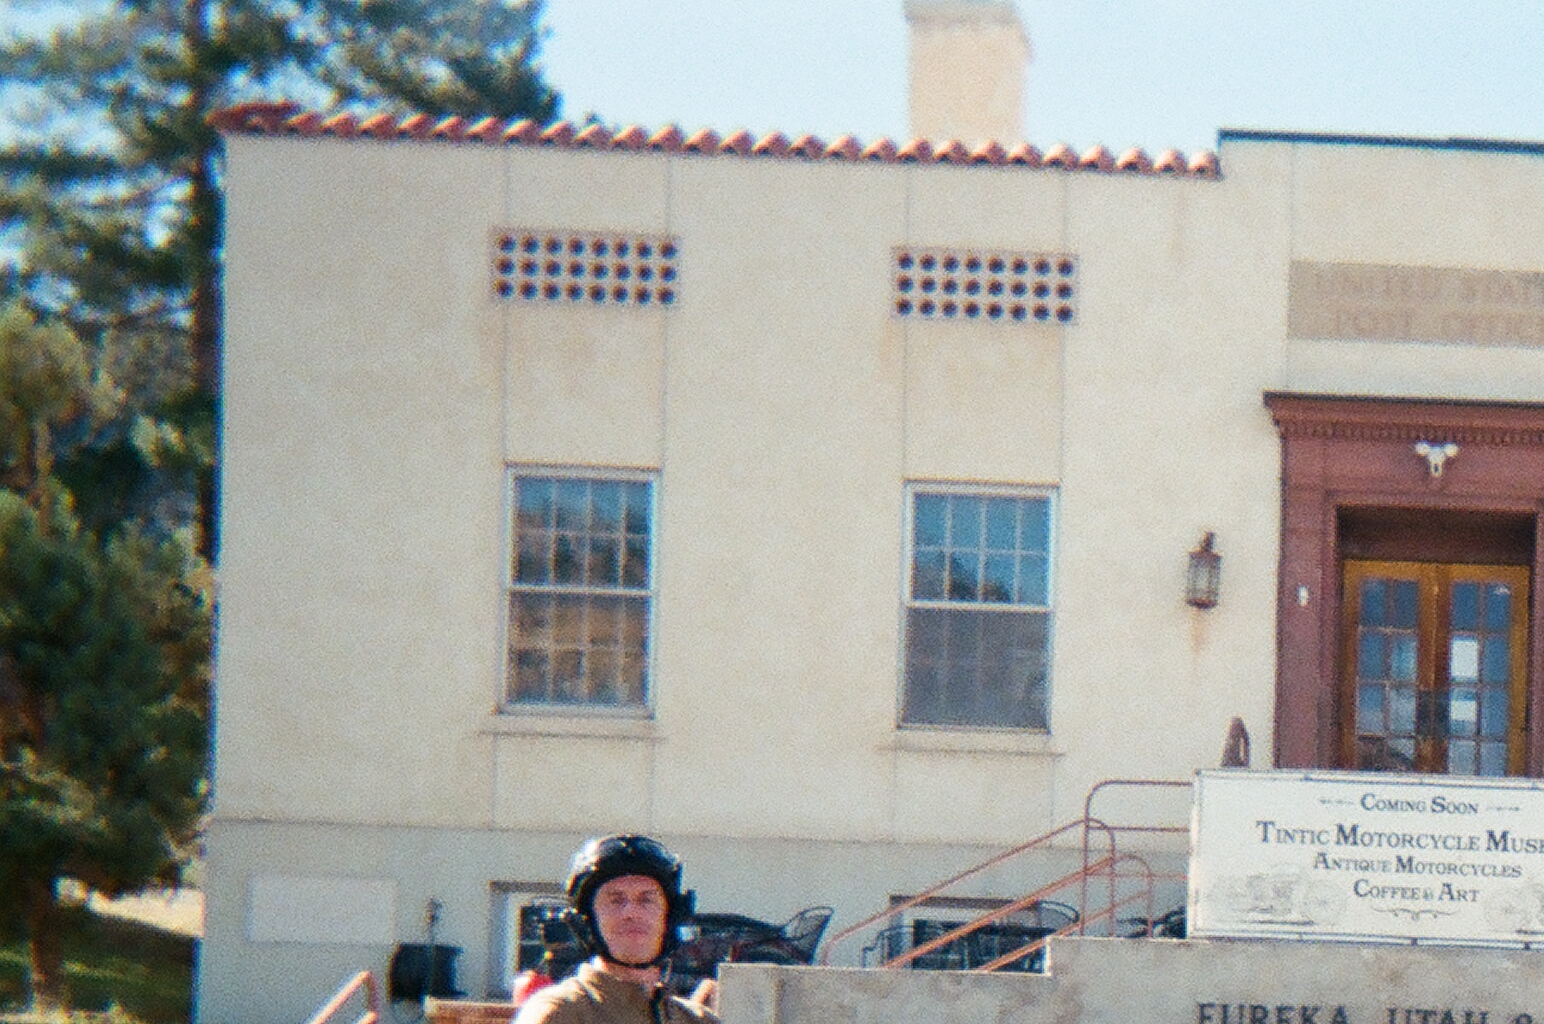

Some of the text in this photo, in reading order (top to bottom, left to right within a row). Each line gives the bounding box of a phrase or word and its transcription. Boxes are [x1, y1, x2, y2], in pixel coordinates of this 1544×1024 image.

[1360, 792, 1479, 815] COMING SOON
[1256, 820, 1330, 845] TINTIC
[1335, 823, 1481, 852] MOTORCYCLE
[1313, 852, 1523, 878] ANTIQUE MOTORCYCLES
[1353, 878, 1420, 900] COFFEE
[1438, 882, 1480, 902] ART
